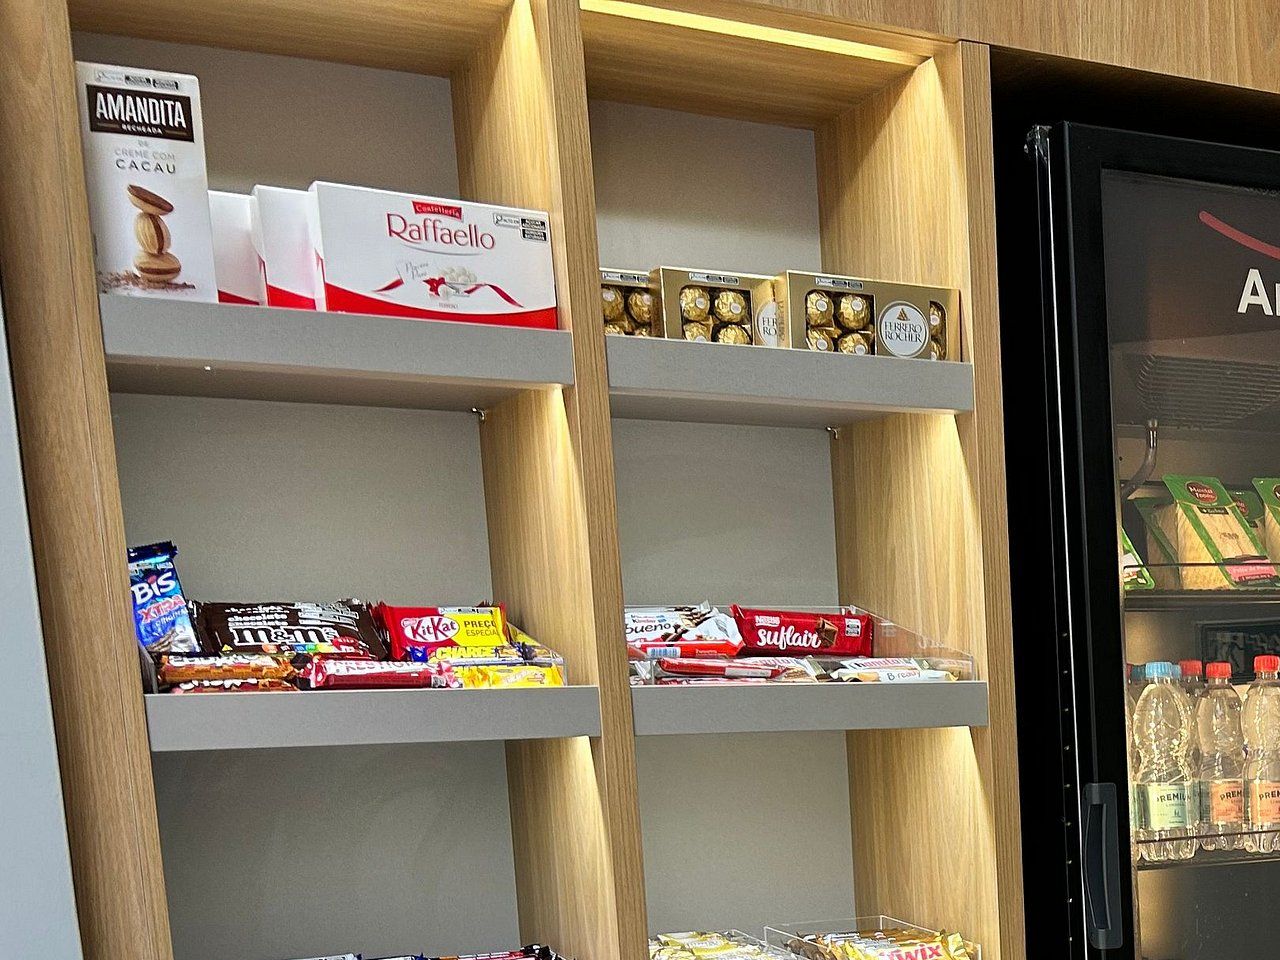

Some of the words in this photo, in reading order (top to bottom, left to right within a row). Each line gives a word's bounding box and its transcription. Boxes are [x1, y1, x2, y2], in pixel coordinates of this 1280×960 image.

[96, 92, 187, 129] AMANDITA
[115, 159, 176, 174] CACAU
[386, 212, 495, 250] Raffaello
[884, 321, 922, 333] FERRERO
[884, 331, 922, 343] ROCHER
[138, 595, 187, 623] XTRA
[625, 622, 671, 635] bueno
[757, 628, 822, 650] suflair
[1219, 790, 1244, 801] PREM
